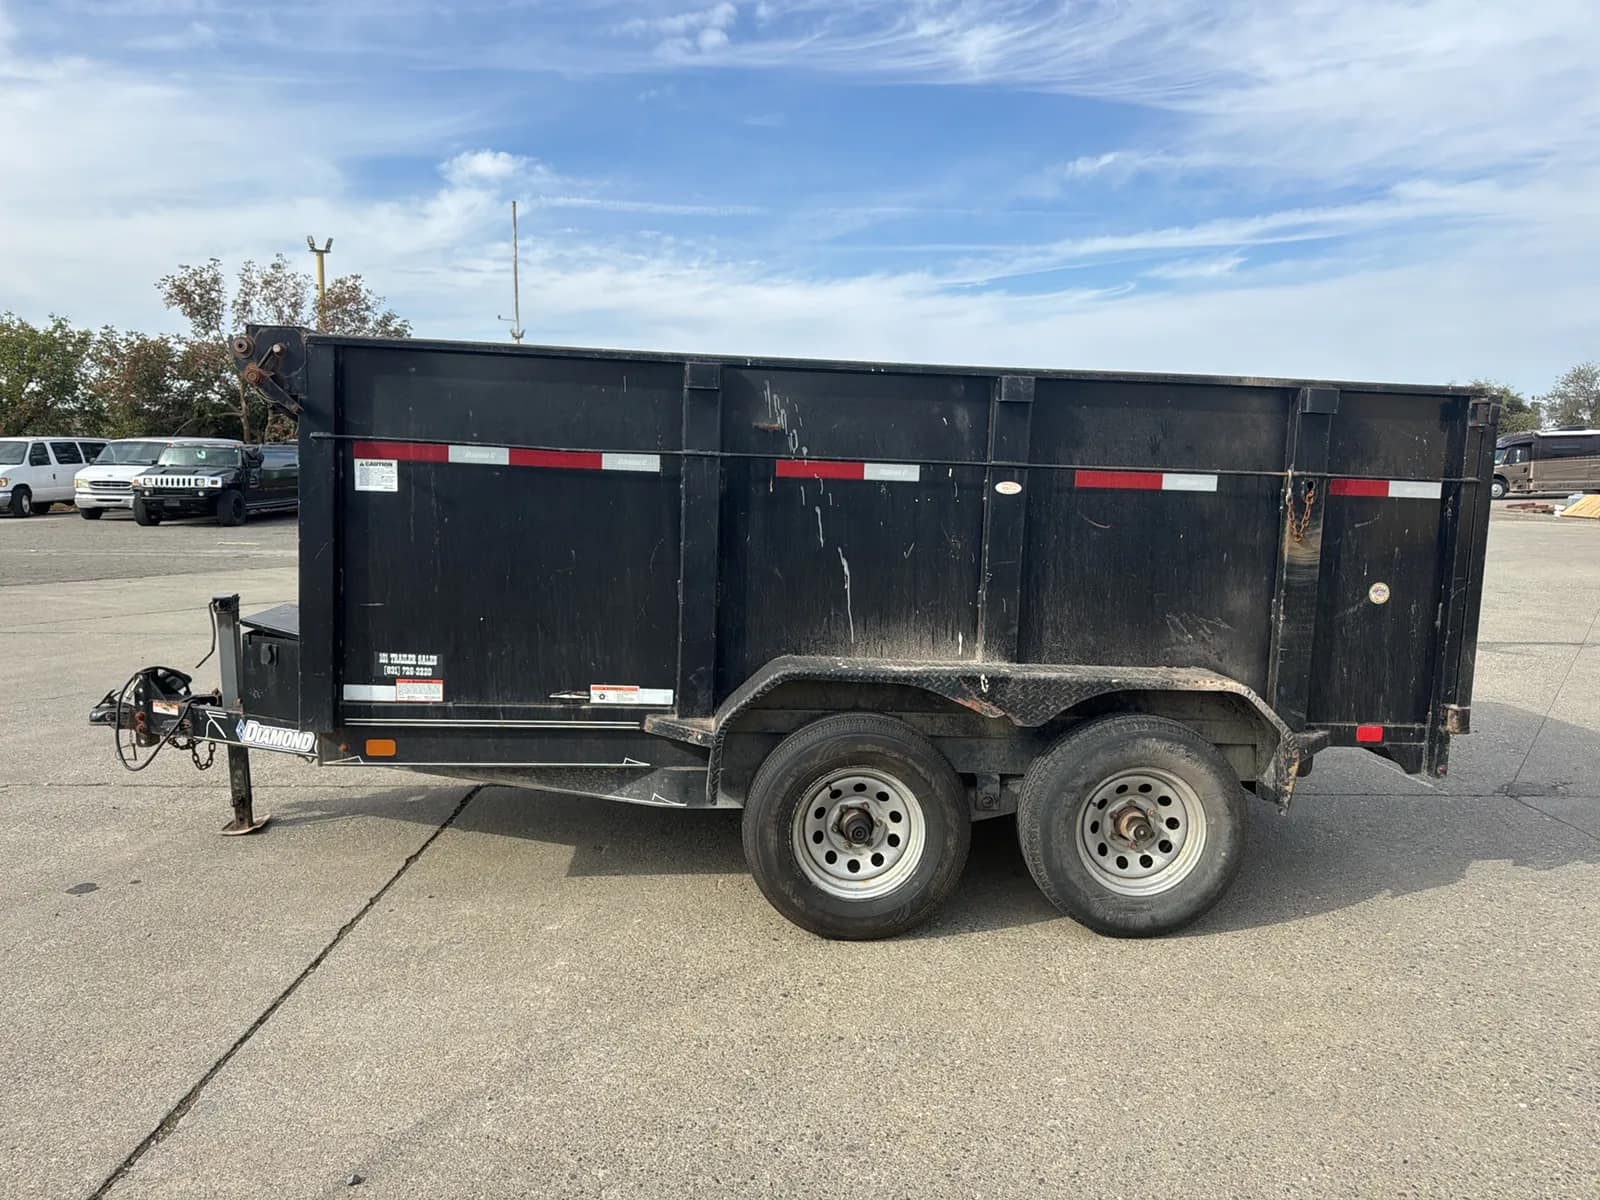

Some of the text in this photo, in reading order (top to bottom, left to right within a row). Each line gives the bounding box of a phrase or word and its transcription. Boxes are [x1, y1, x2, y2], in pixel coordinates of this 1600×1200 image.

[390, 653, 416, 665] TRAILER
[418, 654, 437, 666] SALES
[244, 721, 313, 751] DIAMOND
